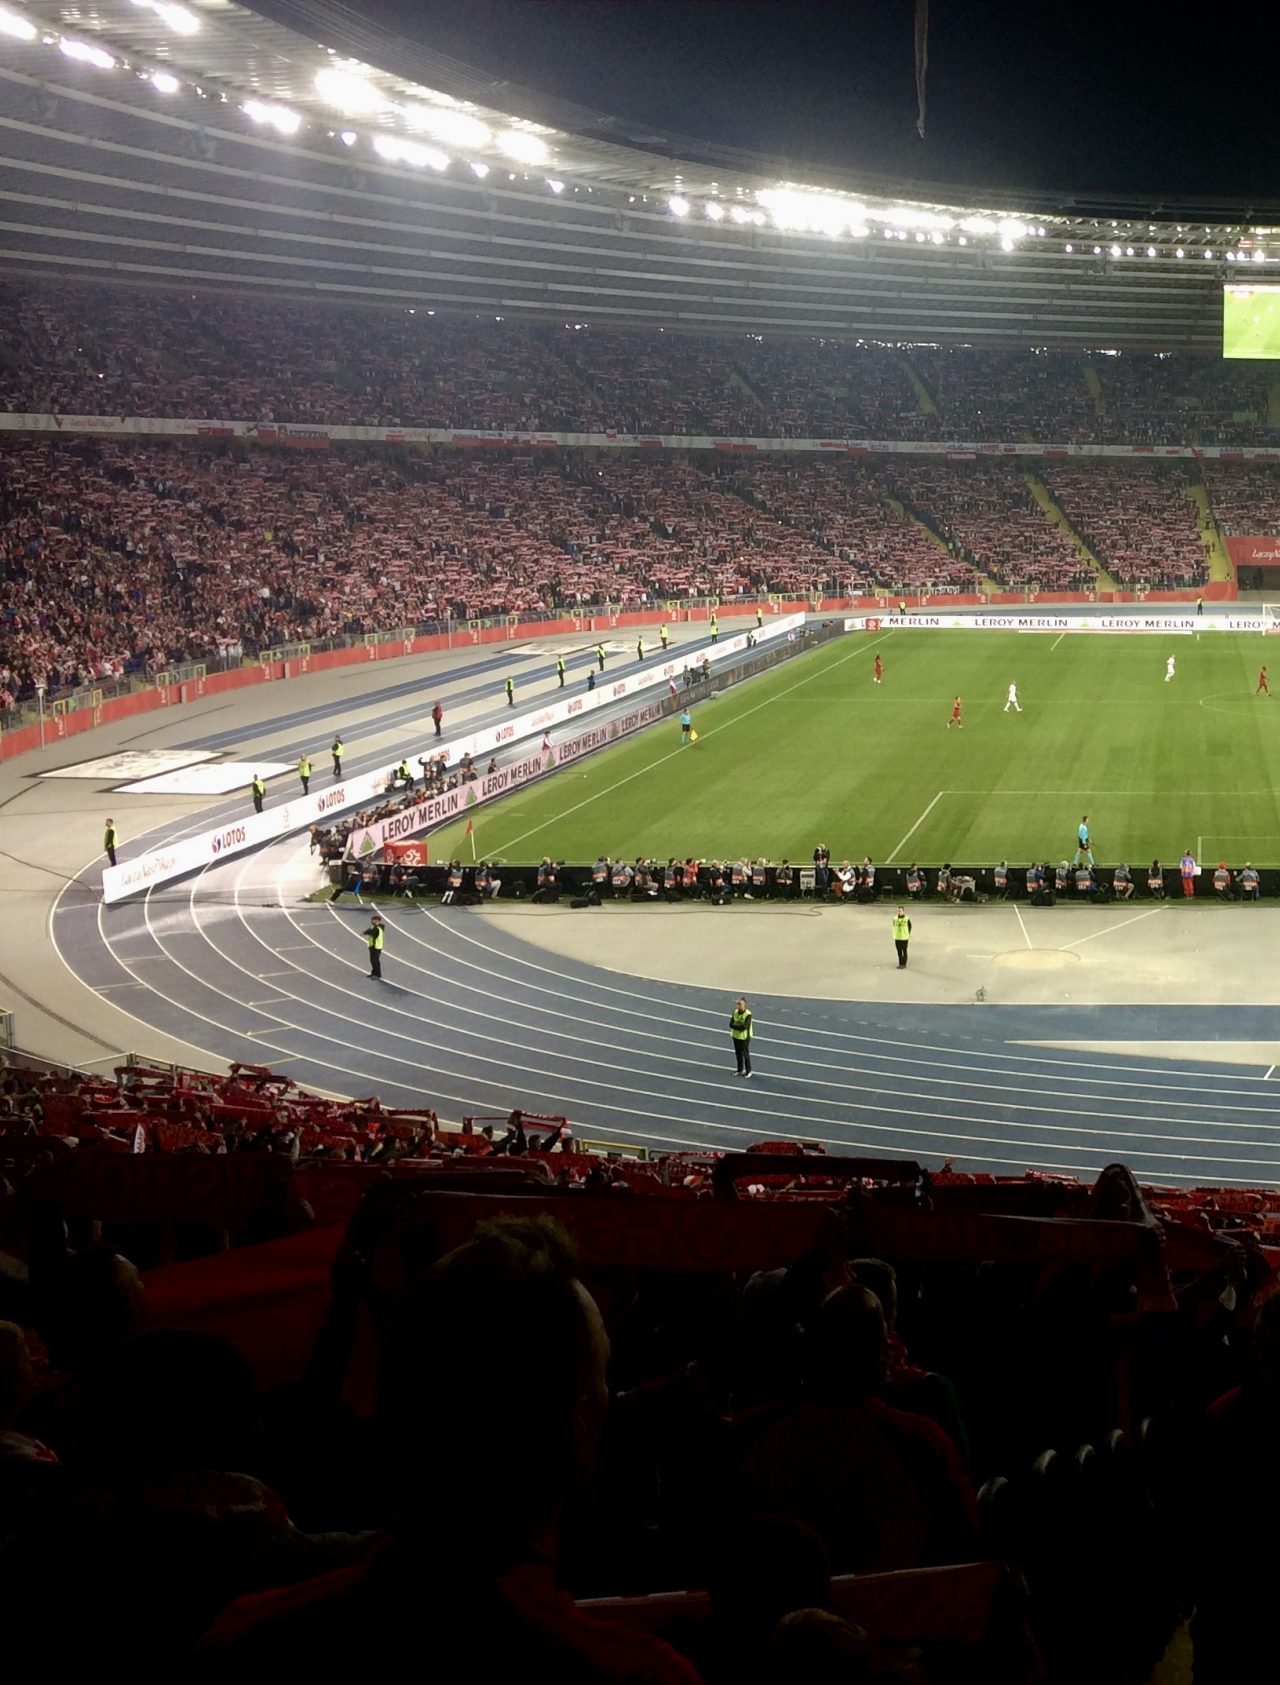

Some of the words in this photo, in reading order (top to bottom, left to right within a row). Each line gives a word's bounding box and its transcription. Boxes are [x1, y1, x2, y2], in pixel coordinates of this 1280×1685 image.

[889, 618, 940, 626] MERLIN
[974, 618, 1015, 627] LEROY
[1018, 618, 1068, 627] MERLIN
[1101, 619, 1140, 628] LEROY
[1144, 620, 1195, 628] MERLIN
[559, 742, 582, 761] LEROY
[581, 727, 607, 747] MERLIN
[482, 772, 509, 797] LEROY
[510, 756, 541, 781] MERLIN
[325, 788, 345, 809] LOTOS
[381, 813, 416, 841] LEROY
[418, 793, 458, 826] MERLIN
[222, 826, 246, 849] LOTOS
